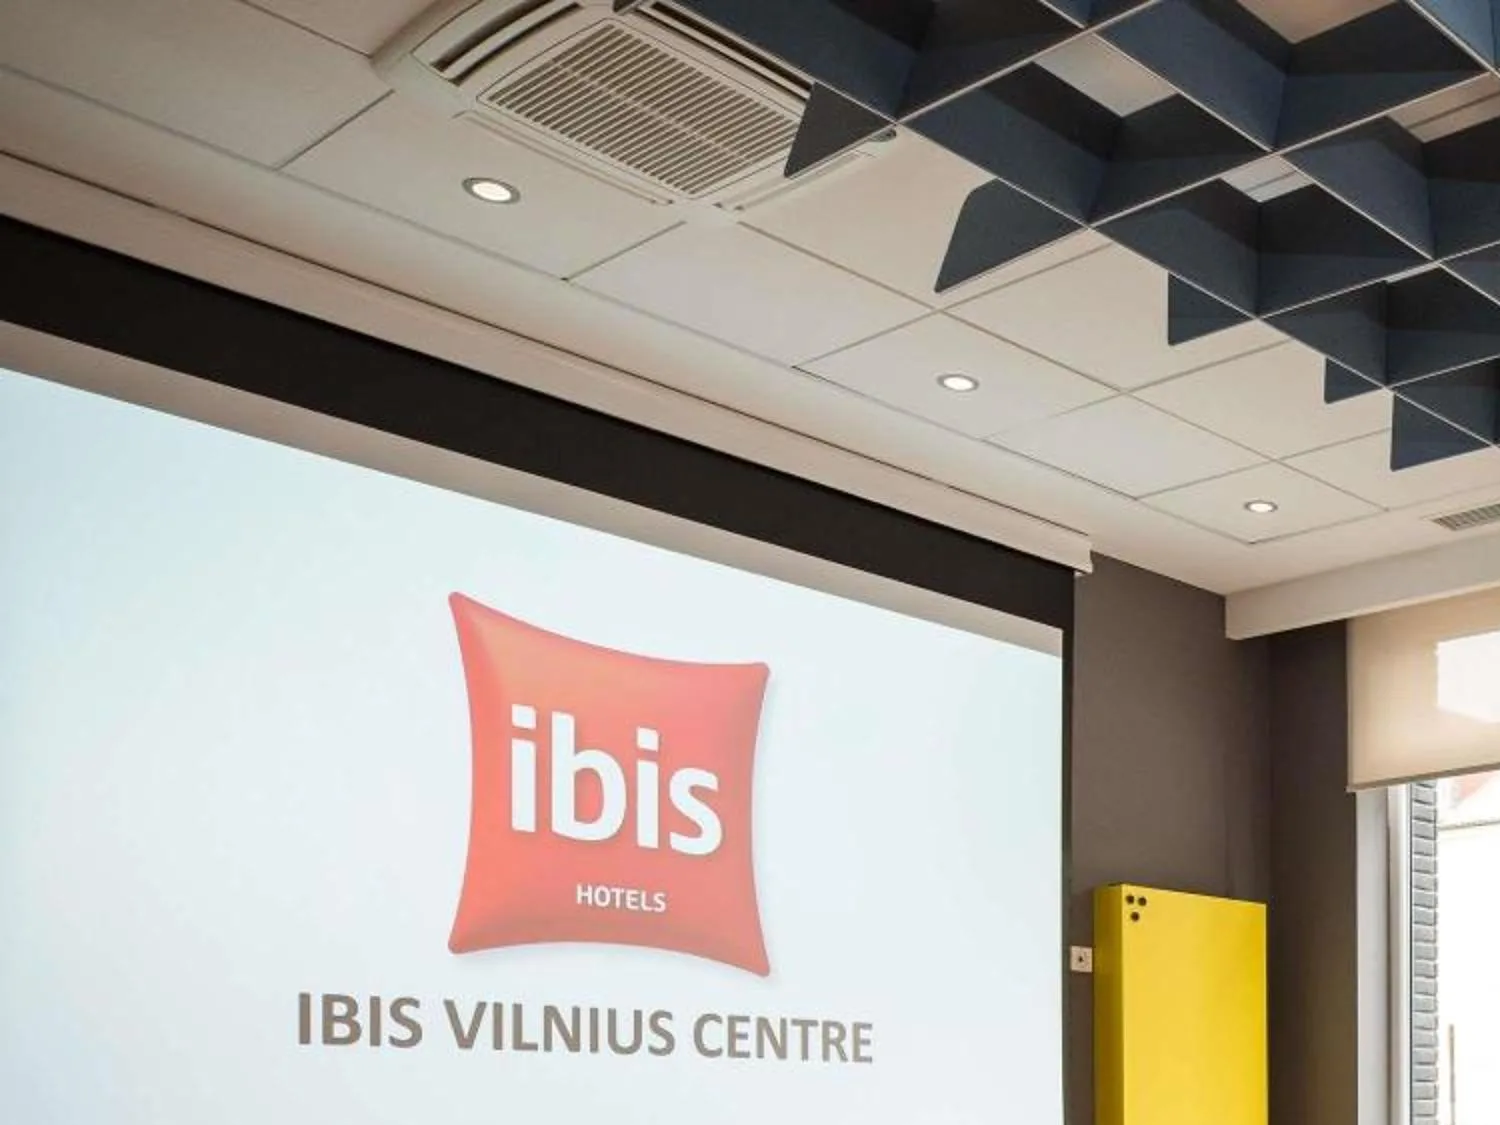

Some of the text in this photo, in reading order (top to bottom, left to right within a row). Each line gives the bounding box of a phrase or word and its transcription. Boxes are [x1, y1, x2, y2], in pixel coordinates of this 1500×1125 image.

[510, 704, 723, 856] ibis
[576, 883, 667, 913] HOTELS
[298, 992, 873, 1064] IBIS VILNIUS CENTRE
